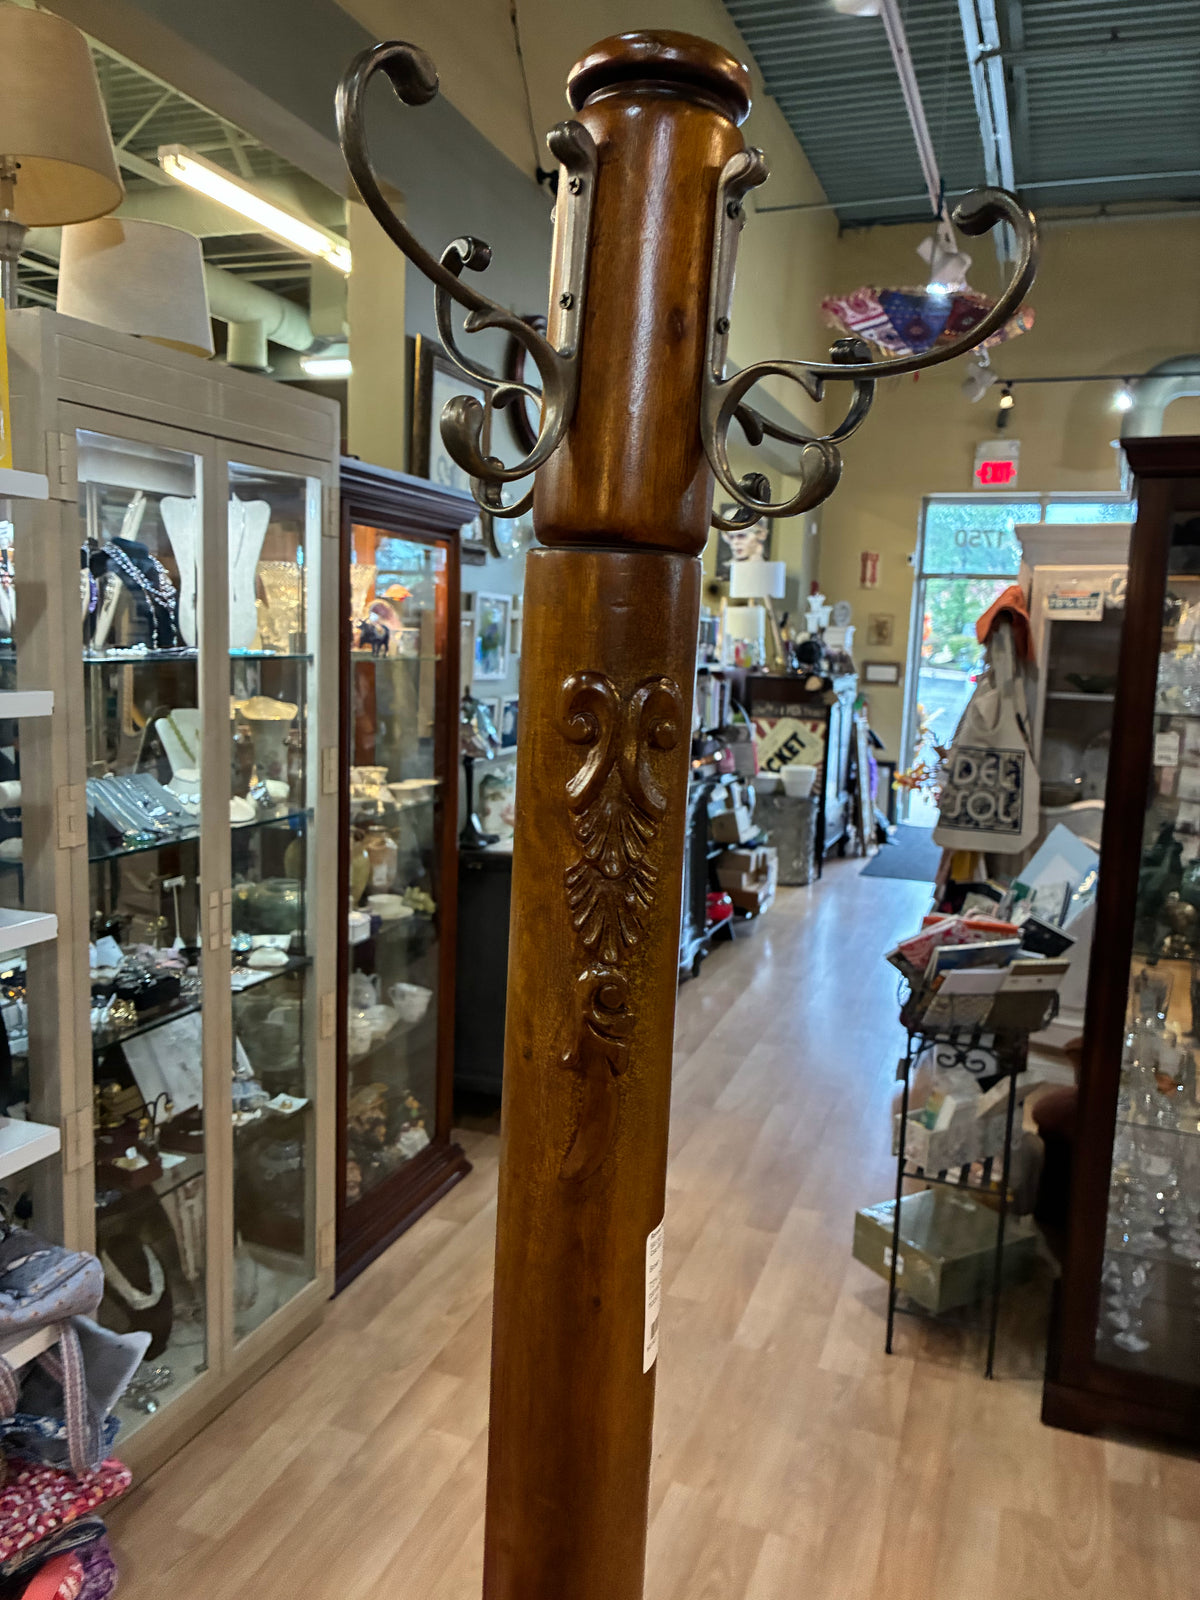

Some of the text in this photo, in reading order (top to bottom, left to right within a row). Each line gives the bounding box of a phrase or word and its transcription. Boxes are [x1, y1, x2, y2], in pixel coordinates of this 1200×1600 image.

[759, 731, 806, 773] CKET
[953, 756, 1019, 788] DEL
[945, 790, 1015, 822] SOL
